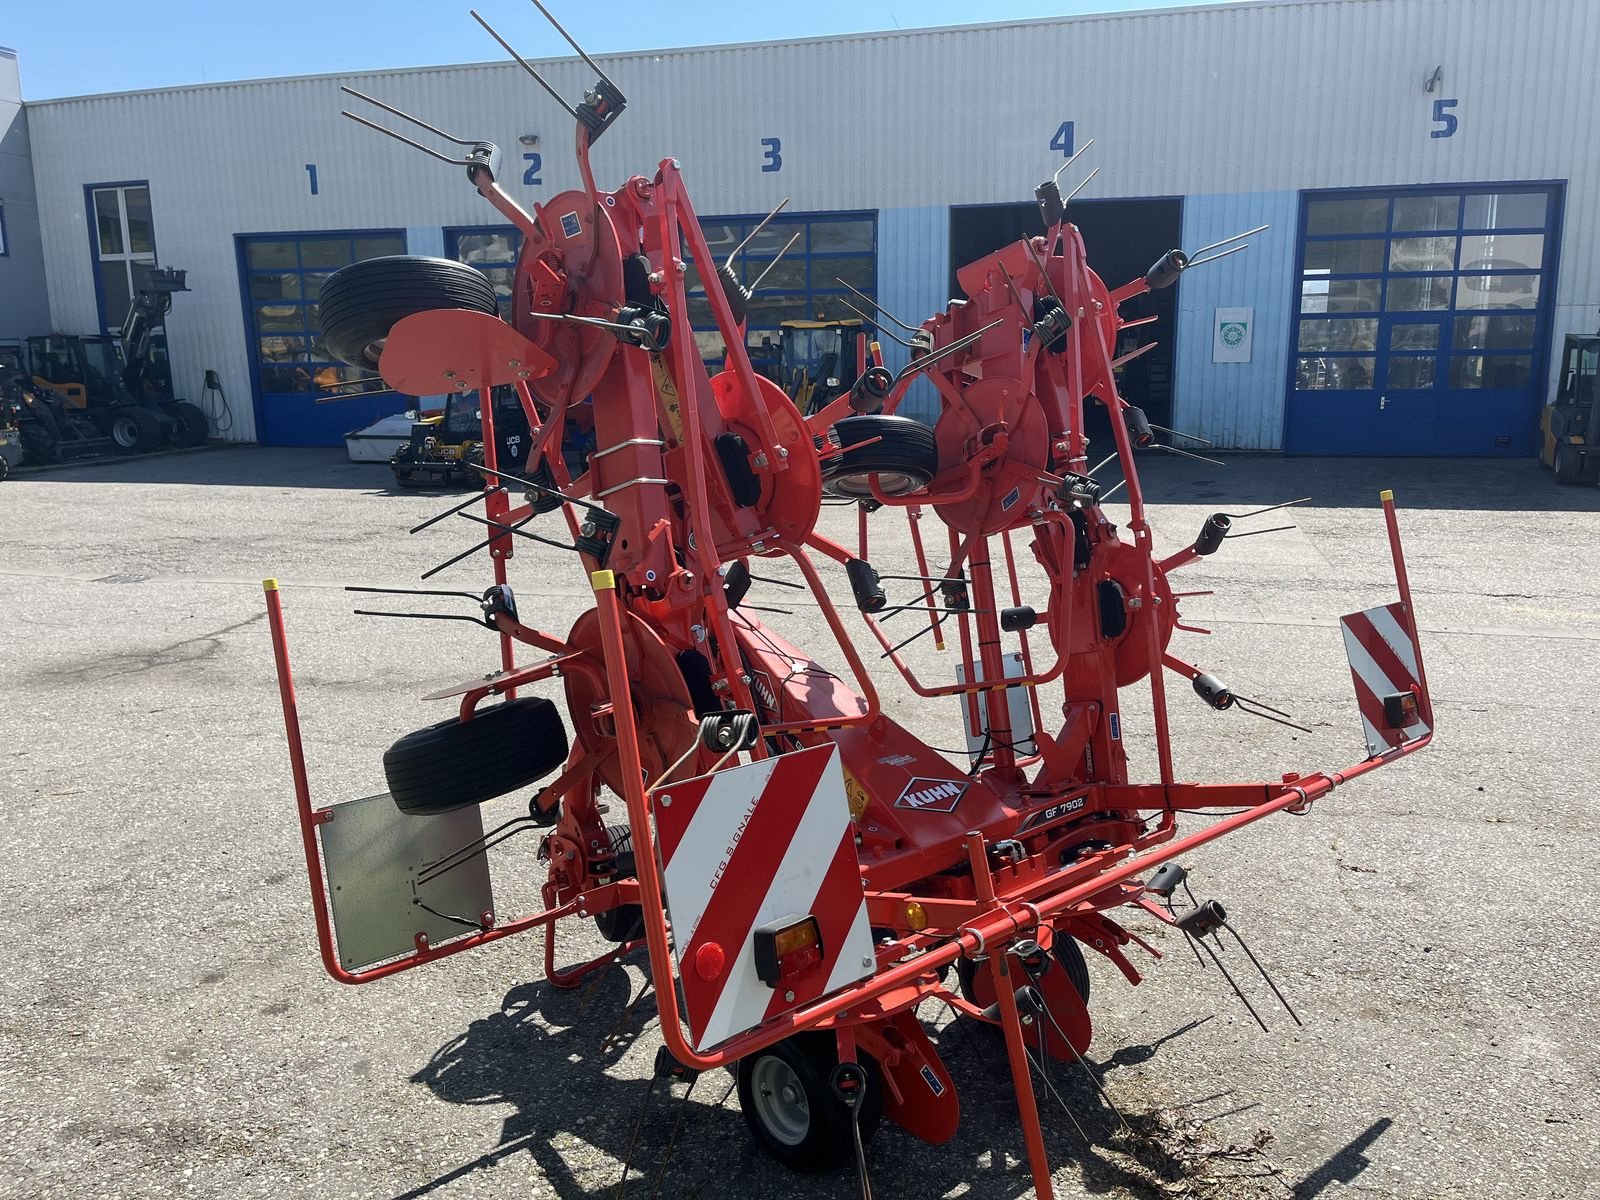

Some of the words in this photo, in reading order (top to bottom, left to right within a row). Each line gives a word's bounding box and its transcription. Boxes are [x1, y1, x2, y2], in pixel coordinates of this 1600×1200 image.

[1430, 99, 1458, 139] 5
[761, 137, 782, 173] 3
[1049, 121, 1074, 158] 4
[305, 164, 318, 195] 1
[523, 152, 542, 186] 2
[506, 435, 520, 445] JCB
[903, 782, 961, 808] KUHN
[1045, 806, 1058, 819] GF
[1060, 797, 1084, 813] 7902
[709, 860, 727, 890] CFG
